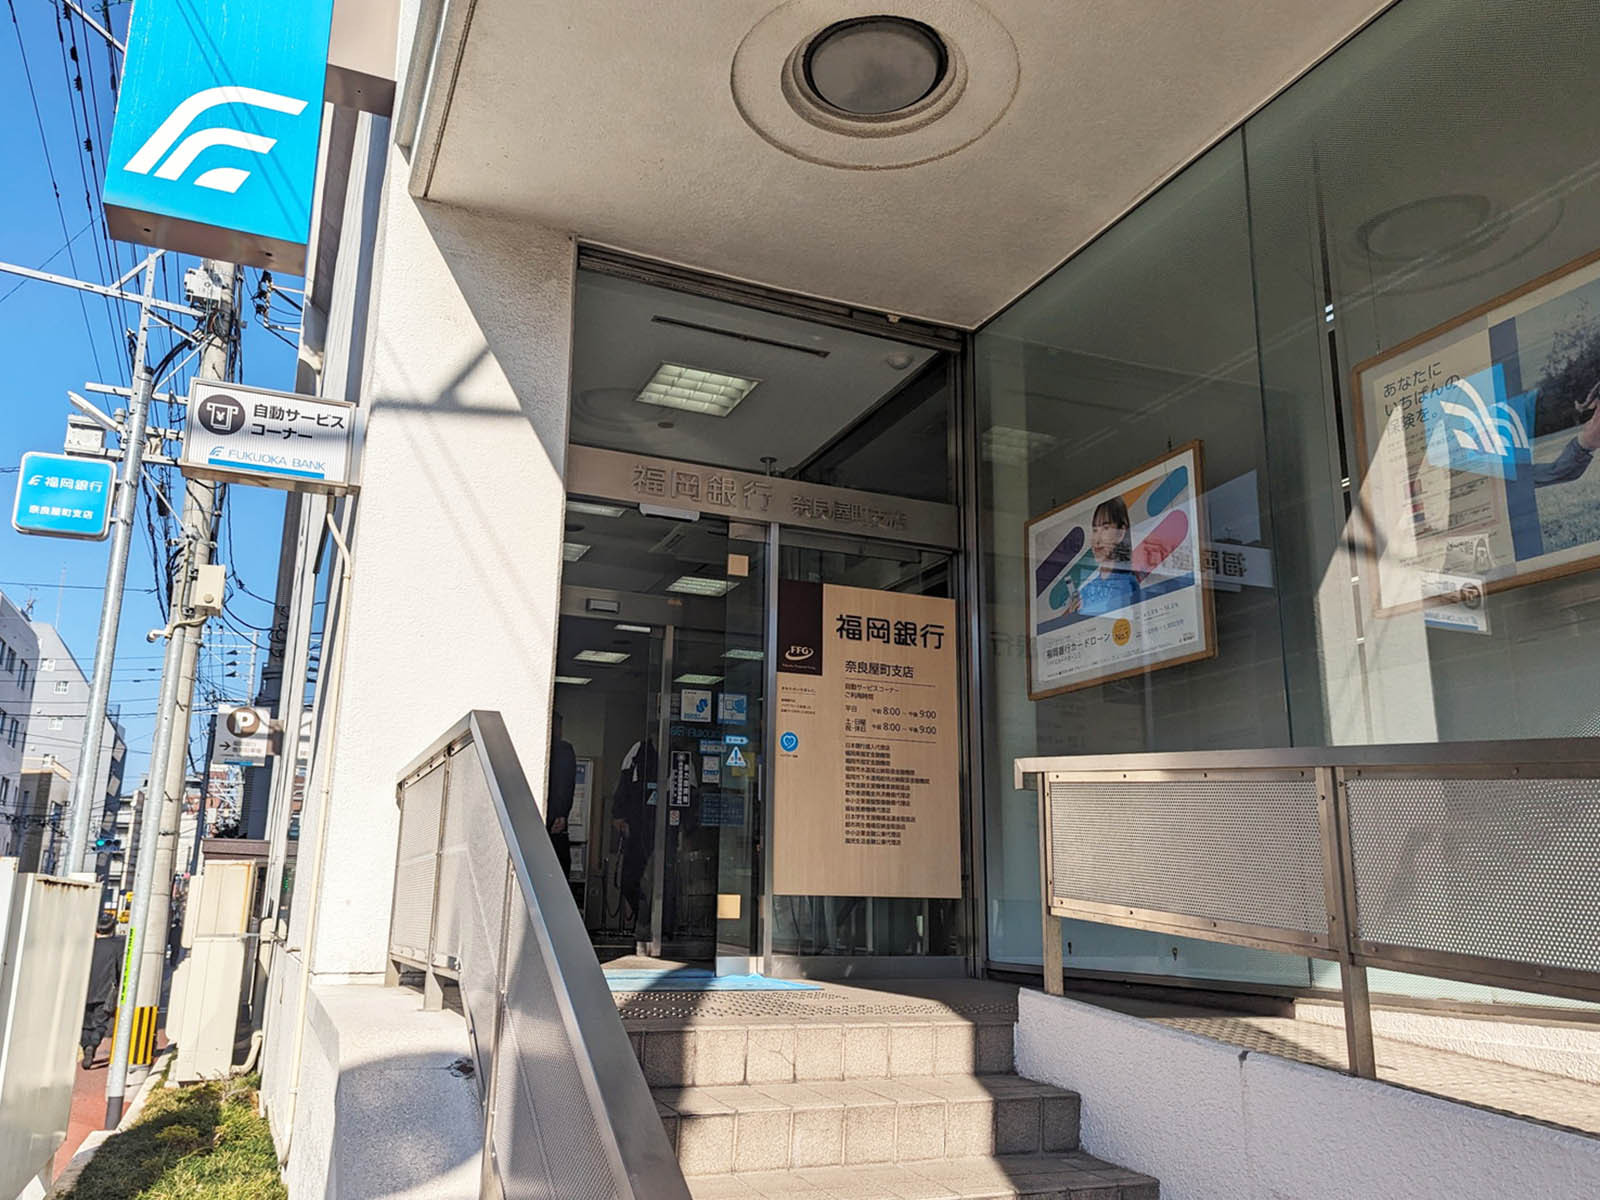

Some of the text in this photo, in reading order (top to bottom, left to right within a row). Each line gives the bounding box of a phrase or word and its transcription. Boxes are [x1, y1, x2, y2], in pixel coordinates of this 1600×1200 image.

[1383, 361, 1442, 398] あなたに
[1384, 374, 1461, 417] いちばんの
[253, 403, 345, 429] 自動サービス
[250, 422, 313, 440] コーナー
[228, 448, 327, 471] FUKUOKA BANK
[45, 475, 104, 493] 福岡銀行
[631, 463, 776, 511] 福岡銀行
[836, 613, 945, 650] 福岡銀行
[790, 645, 809, 655] FFG
[845, 660, 914, 679] 奈良屋町支店
[845, 683, 900, 694] 自動サービスコーナー
[234, 711, 255, 733] P
